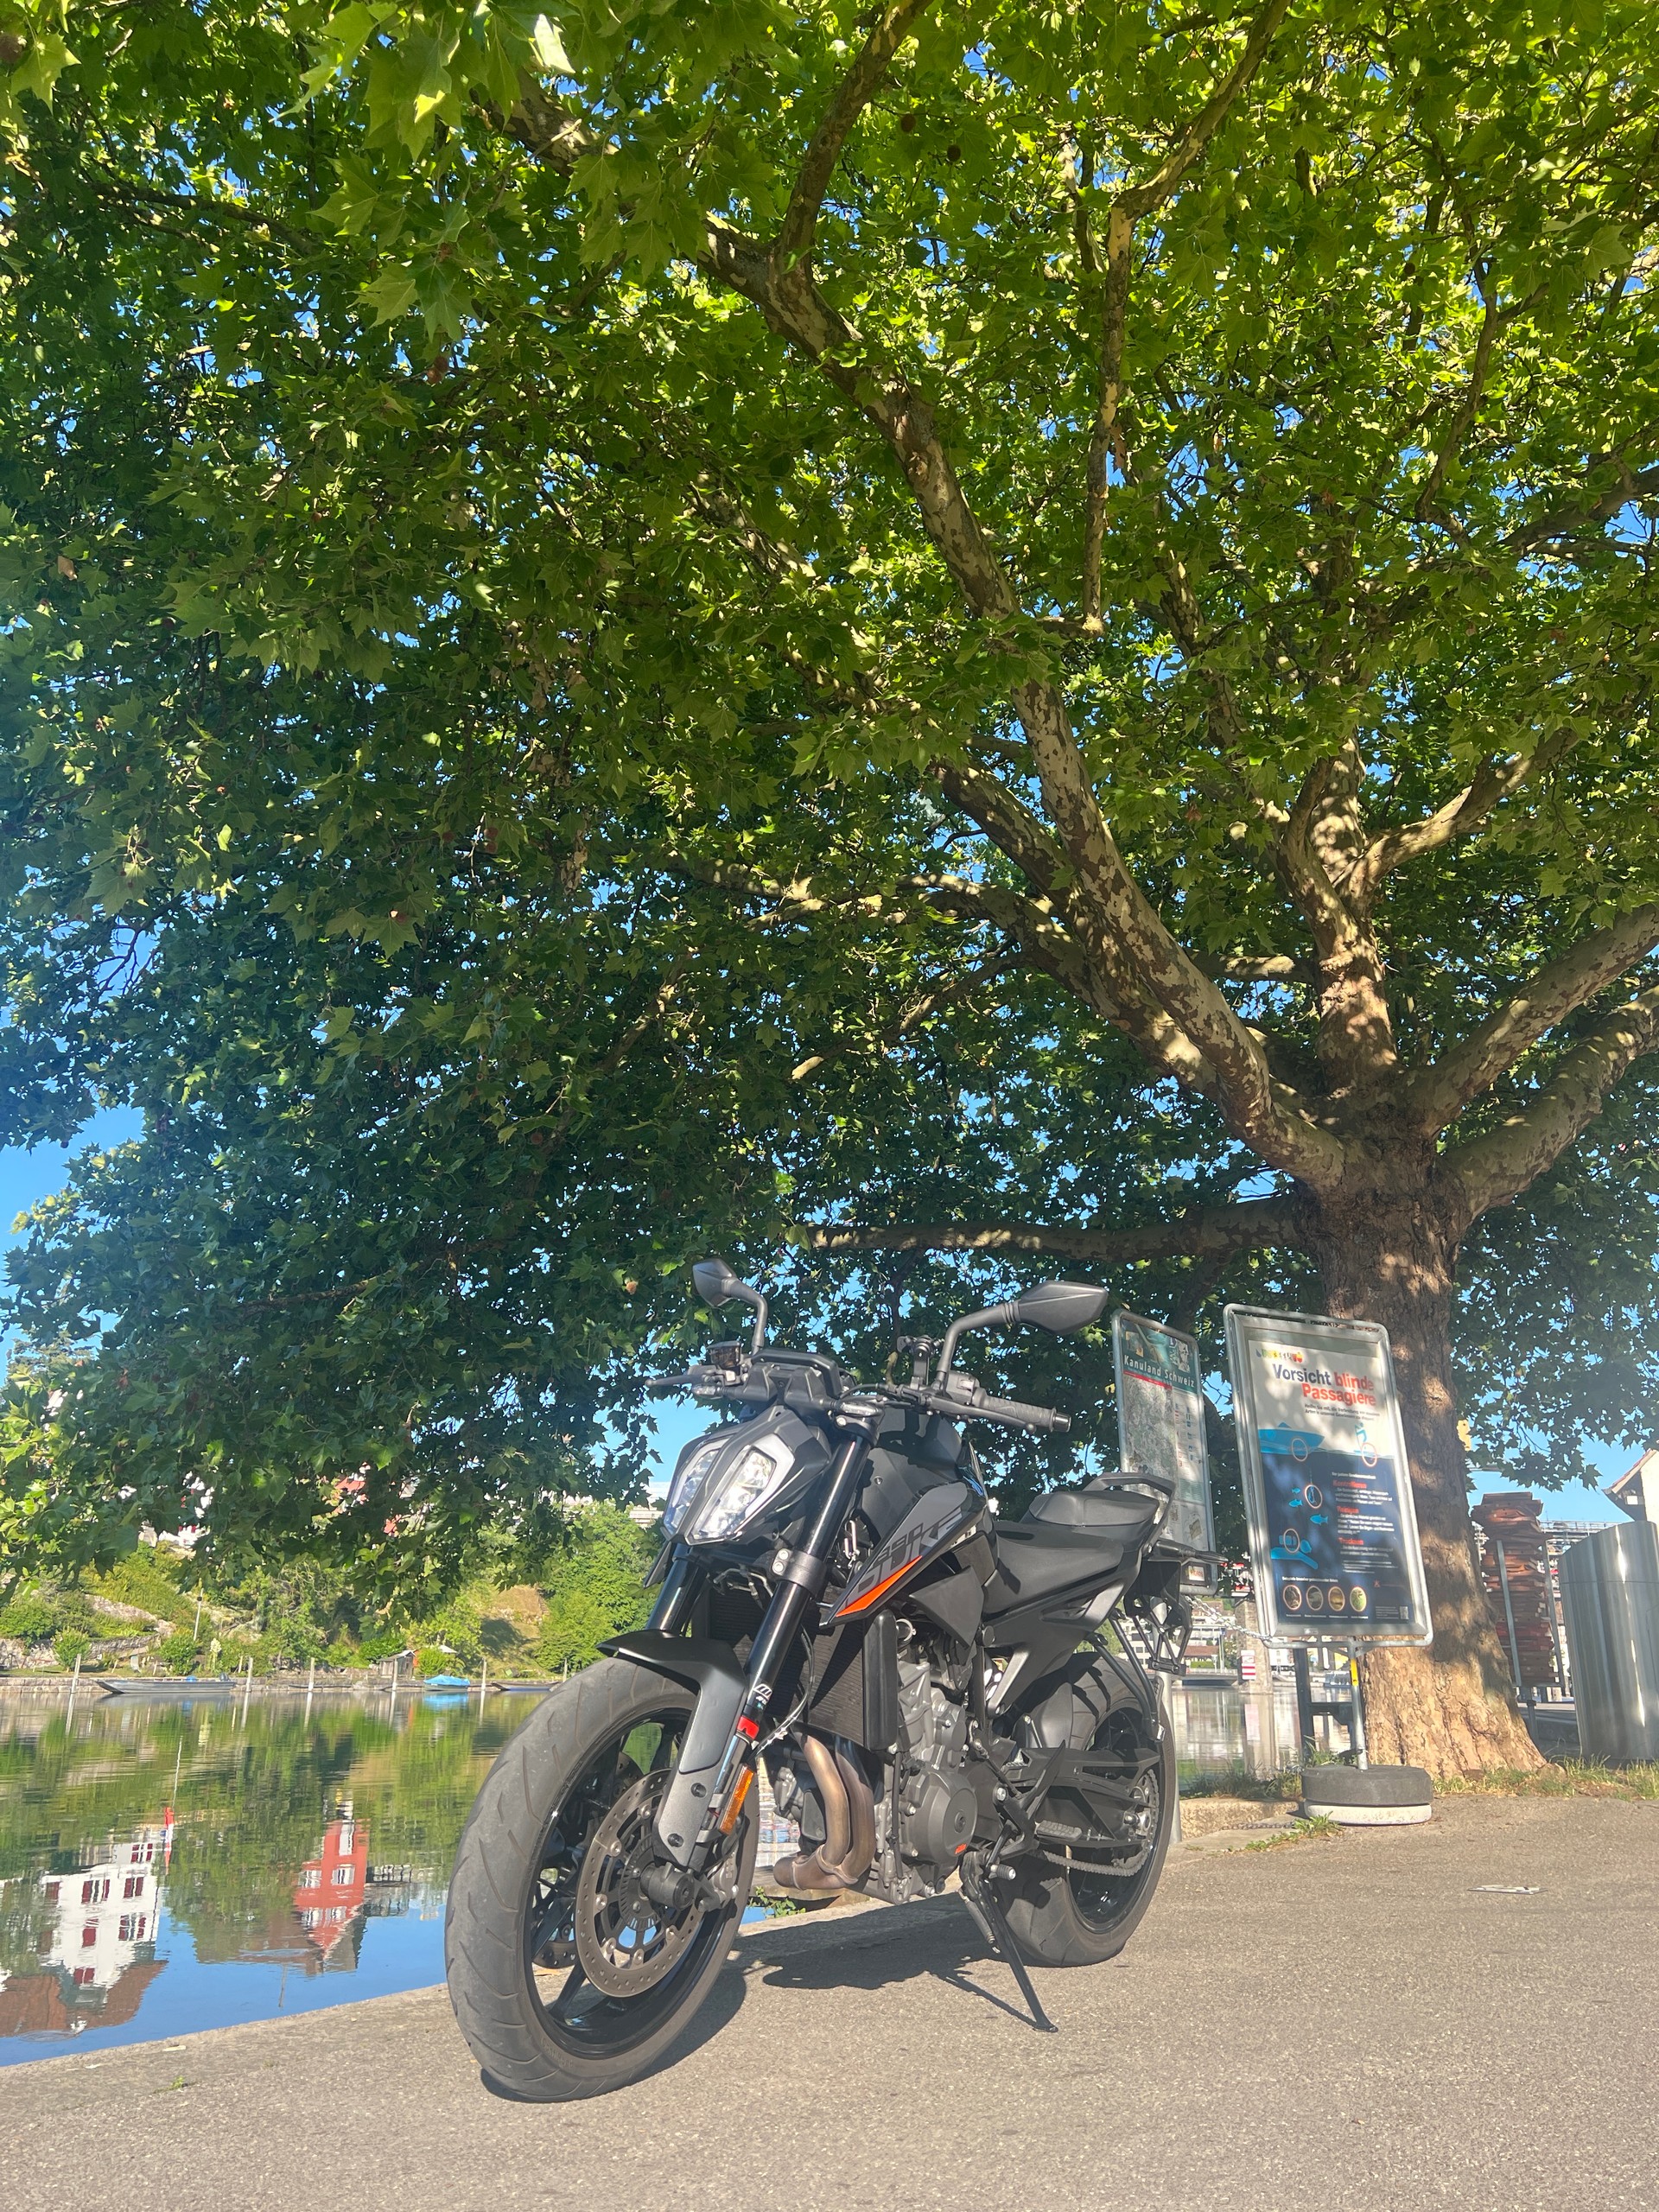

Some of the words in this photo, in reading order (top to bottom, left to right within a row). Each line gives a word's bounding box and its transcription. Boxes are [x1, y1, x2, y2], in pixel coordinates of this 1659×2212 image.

[1124, 1355, 1161, 1376] Kanuland
[1164, 1369, 1195, 1388] Schweiz
[1273, 1363, 1332, 1386] Vorsicht
[1333, 1371, 1375, 1391] blinde
[1301, 1383, 1376, 1406] Passagiere
[846, 1506, 963, 1605] DUKE
